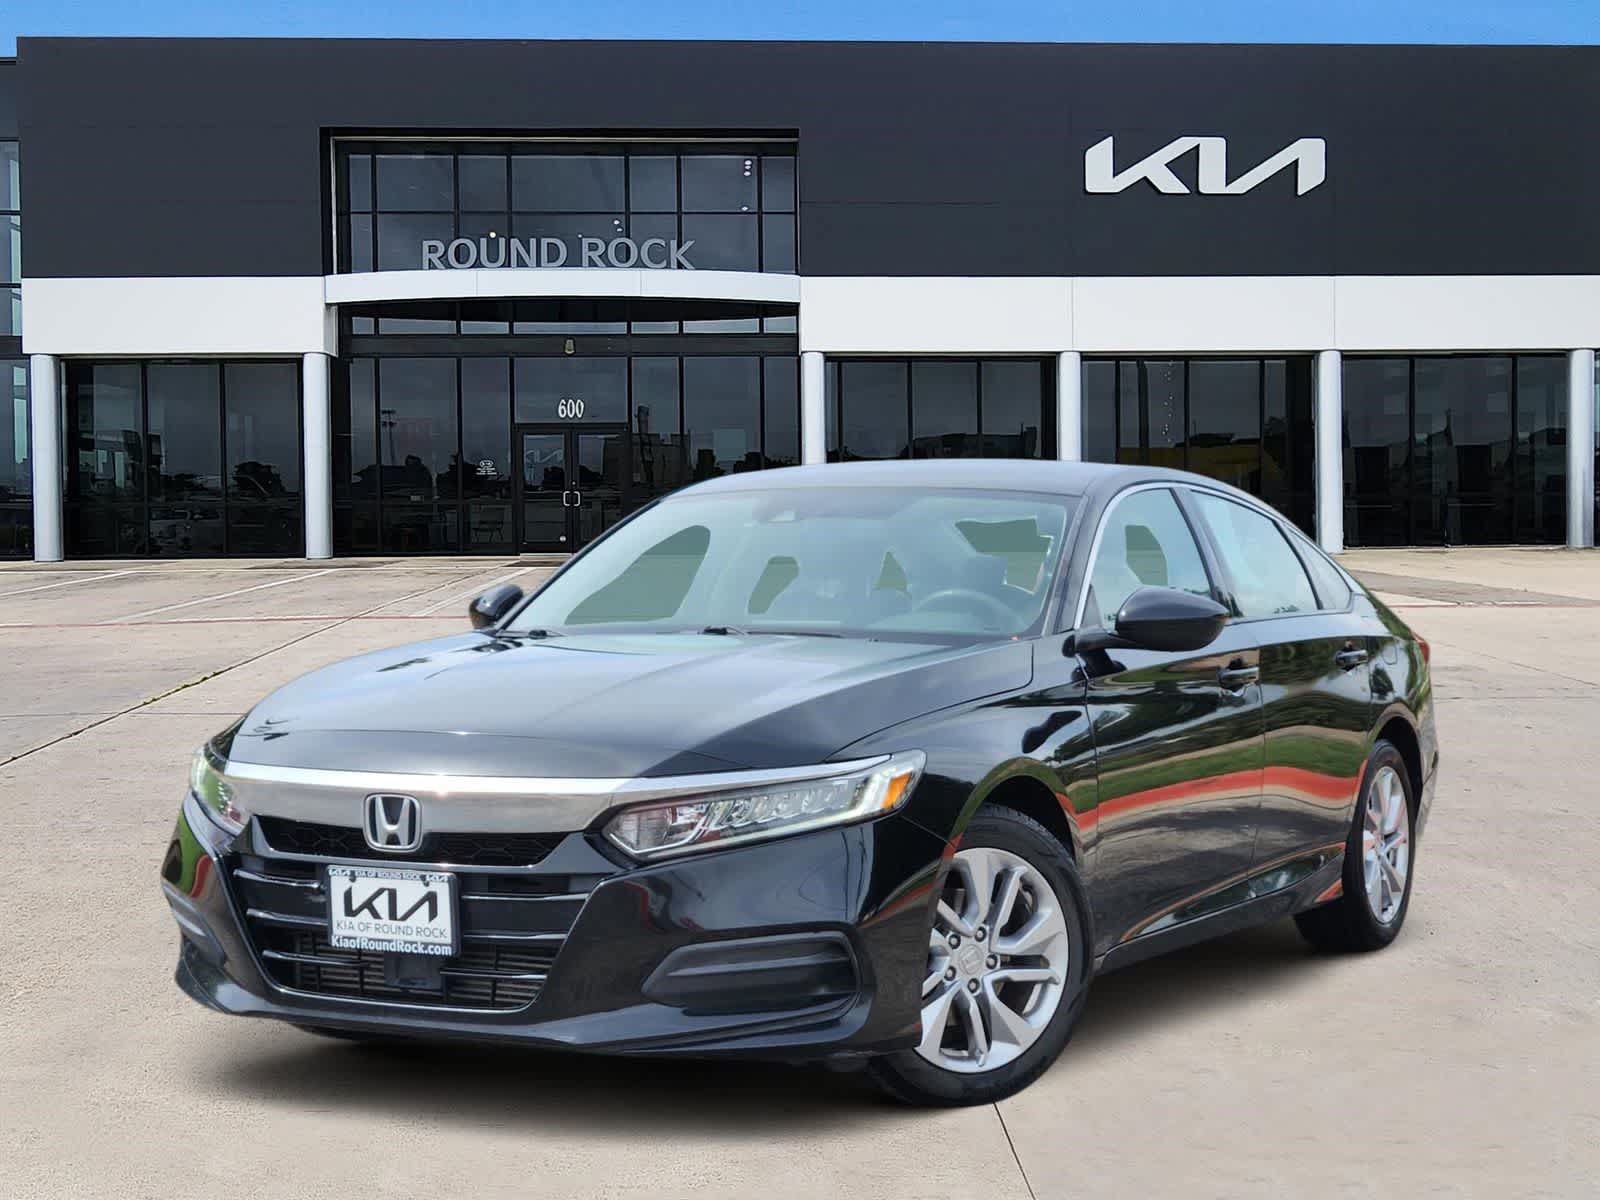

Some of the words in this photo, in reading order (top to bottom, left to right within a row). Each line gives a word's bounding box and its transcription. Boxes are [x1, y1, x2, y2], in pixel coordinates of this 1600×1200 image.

[1085, 135, 1326, 196] KIA
[421, 237, 568, 270] ROUND
[581, 237, 696, 270] ROCK
[558, 399, 584, 418] 600
[344, 886, 438, 923] KIA
[336, 920, 355, 931] KIA
[358, 922, 372, 932] OF
[374, 923, 413, 936] ROUND
[416, 927, 447, 938] ROCK
